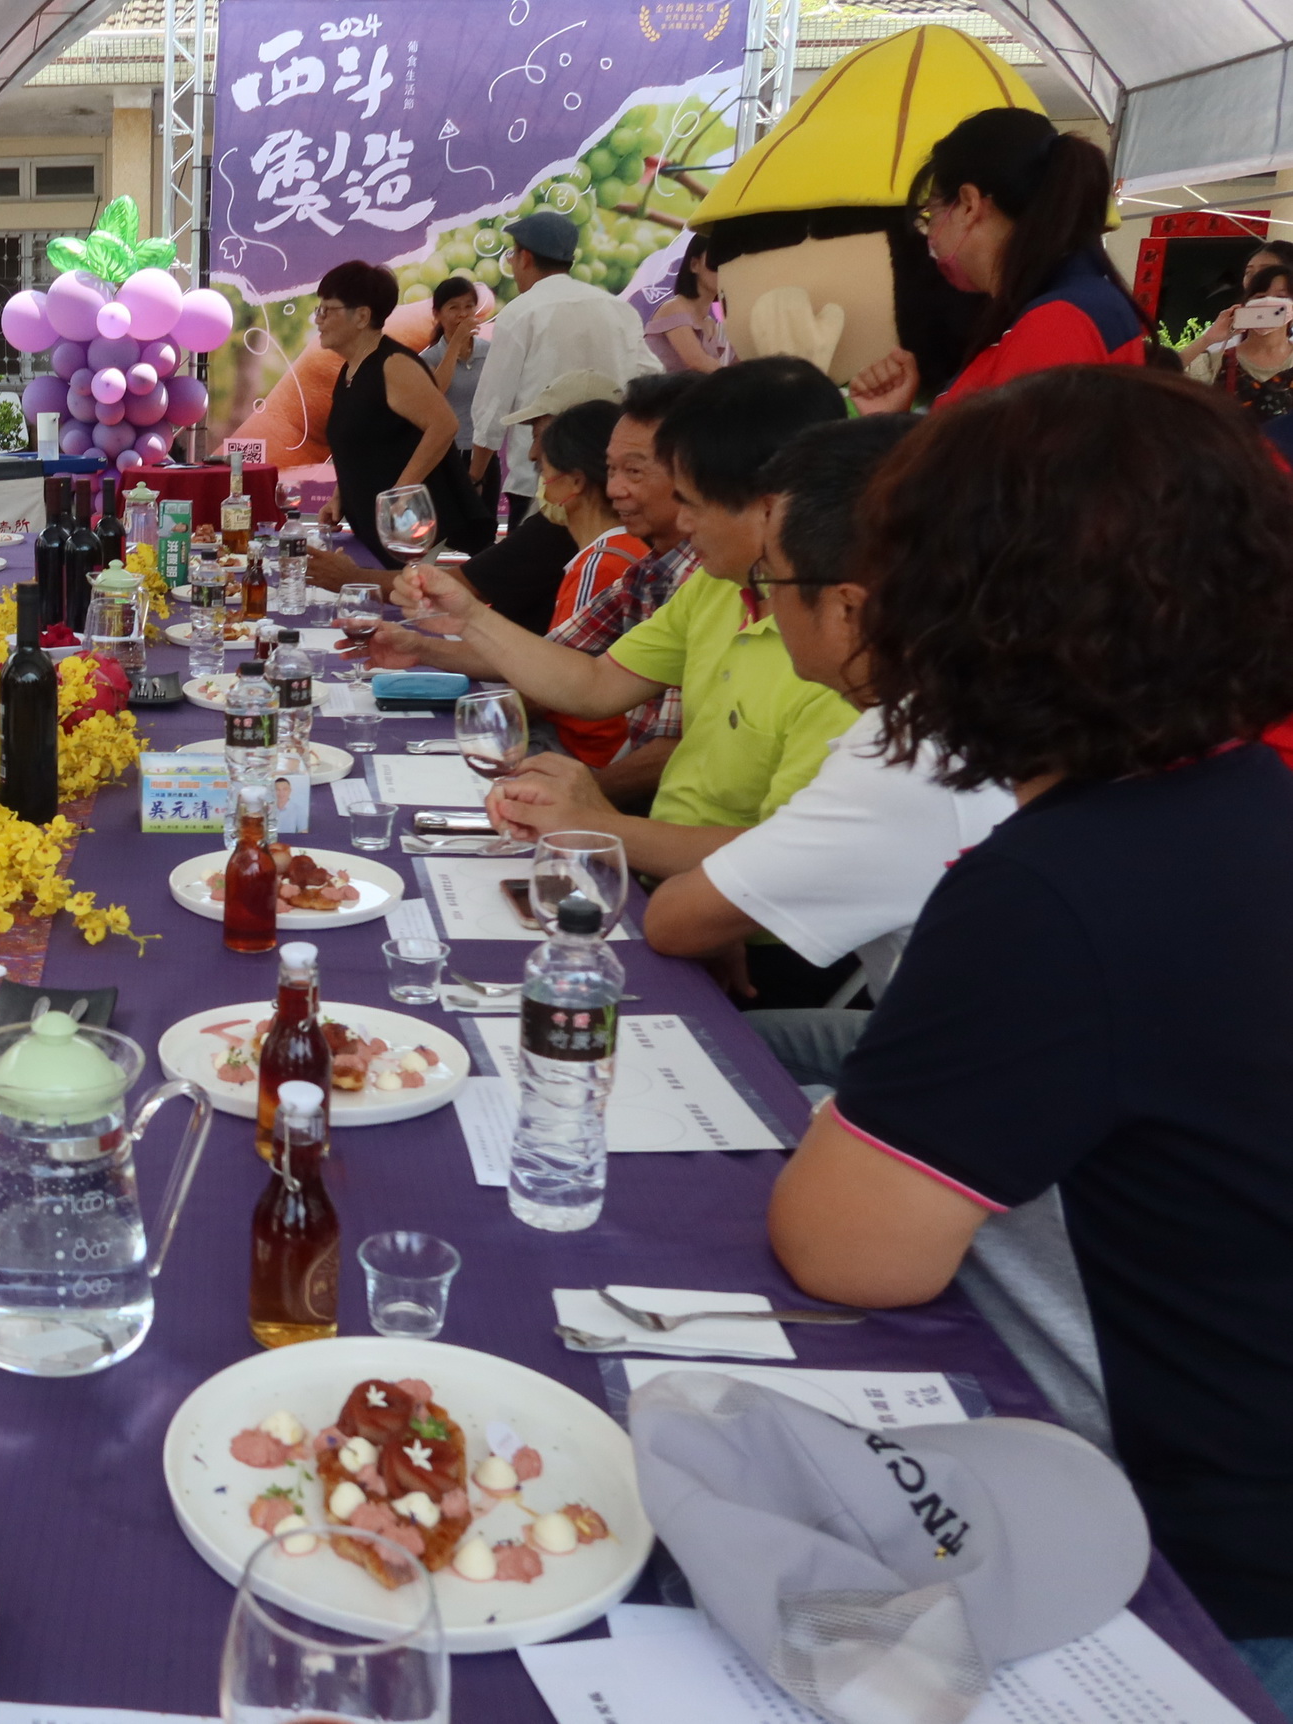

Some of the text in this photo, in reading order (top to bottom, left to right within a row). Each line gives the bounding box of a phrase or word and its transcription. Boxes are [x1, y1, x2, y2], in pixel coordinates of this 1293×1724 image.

[319, 13, 383, 42] 2024
[231, 29, 394, 120] 西斗
[402, 40, 419, 110] 葡食生活節
[250, 128, 438, 237] 製造
[149, 800, 214, 820] 吳元清
